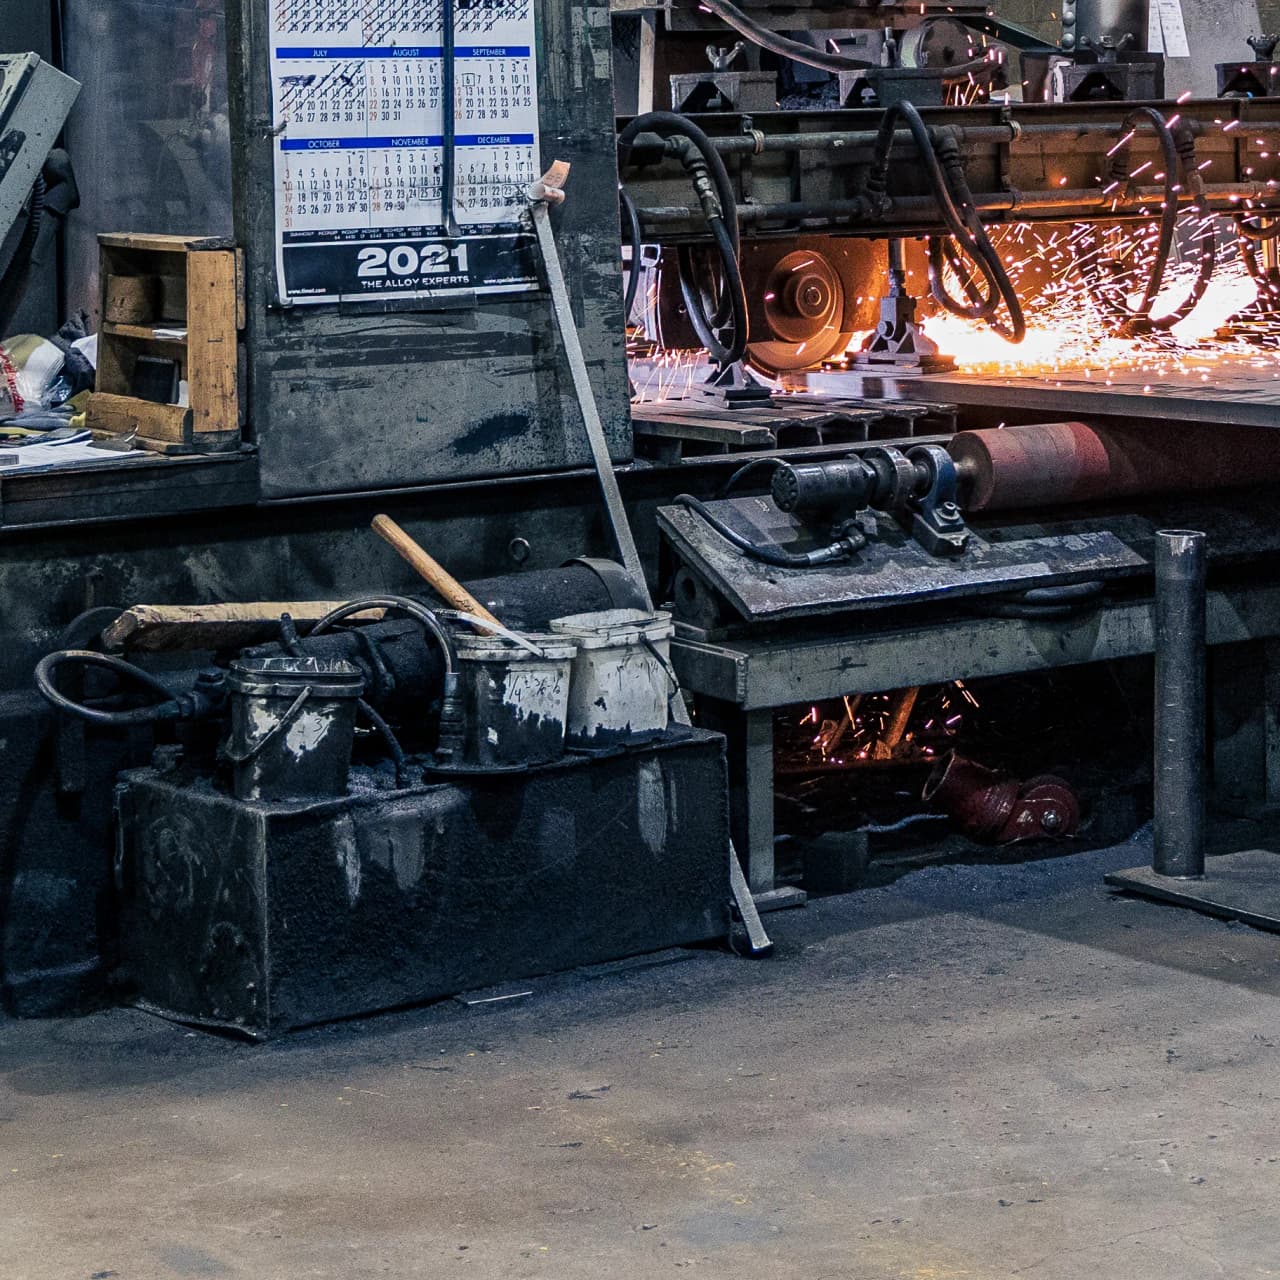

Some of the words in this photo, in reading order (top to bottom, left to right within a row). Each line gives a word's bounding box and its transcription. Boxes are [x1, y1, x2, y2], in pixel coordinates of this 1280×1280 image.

[313, 48, 328, 57] JULY
[392, 48, 420, 57] AUGUST
[473, 48, 506, 56] SEPTEMBER
[500, 64, 504, 72] 2
[512, 64, 516, 72] 3
[523, 64, 528, 72] 4
[393, 76, 400, 85] 10
[405, 76, 412, 84] 11
[417, 76, 424, 84] 12
[429, 76, 436, 84] 13
[466, 76, 470, 84] 6
[477, 75, 481, 84] 7
[489, 75, 493, 84] 8
[500, 75, 505, 84] 9
[511, 75, 519, 84] 10
[523, 75, 529, 83] 11
[381, 87, 389, 96] 16
[393, 87, 400, 96] 17
[406, 87, 413, 96] 18
[418, 87, 425, 96] 19
[429, 87, 437, 96] 20
[466, 87, 473, 96] 13
[477, 87, 484, 96] 14
[489, 87, 496, 95] 15
[500, 87, 507, 95] 16
[512, 87, 519, 95] 17
[523, 86, 530, 95] 18
[381, 100, 389, 109] 23
[393, 100, 401, 109] 24
[405, 99, 413, 108] 25
[418, 99, 425, 108] 26
[430, 99, 437, 108] 27
[466, 99, 473, 107] 20
[477, 99, 484, 107] 21
[489, 98, 497, 107] 22
[501, 98, 508, 107] 23
[512, 98, 520, 107] 24
[524, 98, 531, 106] 25
[381, 112, 389, 121] 30
[393, 111, 400, 120] 31
[466, 111, 473, 119] 27
[478, 110, 486, 119] 28
[490, 110, 497, 119] 29
[501, 110, 509, 118] 30
[308, 140, 340, 148] OCTOBER
[392, 138, 428, 146] NOVEMBER
[477, 136, 510, 144] DECEMBER
[359, 155, 364, 164] 2
[298, 169, 302, 178] 4
[311, 168, 315, 177] 5
[323, 168, 327, 177] 6
[336, 168, 340, 176] 7
[348, 168, 352, 177] 8
[359, 166, 364, 176] 9
[421, 165, 427, 174] 11
[384, 178, 392, 187] 15
[396, 178, 404, 187] 16
[421, 177, 428, 186] 18
[433, 176, 440, 185] 19
[480, 175, 488, 184] 14
[492, 175, 500, 184] 15
[504, 174, 511, 183] 16
[516, 174, 523, 182] 17
[297, 180, 304, 190] 11
[310, 180, 318, 190] 12
[322, 180, 330, 190] 13
[335, 180, 343, 188] 14
[347, 179, 354, 188] 15
[359, 178, 367, 188] 16
[384, 190, 392, 199] 22
[396, 189, 405, 199] 23
[421, 188, 428, 197] 25
[433, 188, 440, 197] 26
[469, 187, 476, 196] 20
[480, 187, 487, 196] 21
[492, 186, 500, 195] 22
[504, 186, 511, 195] 23
[298, 192, 306, 202] 18
[311, 192, 318, 202] 19
[323, 192, 331, 201] 20
[335, 191, 343, 201] 21
[347, 191, 355, 200] 22
[359, 190, 367, 200] 23
[385, 202, 393, 211] 29
[469, 199, 476, 208] 27
[480, 199, 488, 208] 28
[297, 205, 306, 214] 25
[310, 205, 319, 214] 26
[323, 204, 331, 213] 27
[336, 204, 344, 213] 28
[347, 203, 355, 213] 29
[359, 203, 368, 212] 30
[357, 243, 468, 277] 2021
[361, 280, 382, 288] THE
[384, 278, 419, 287] ALLOY
[422, 275, 469, 285] EXPERTS
